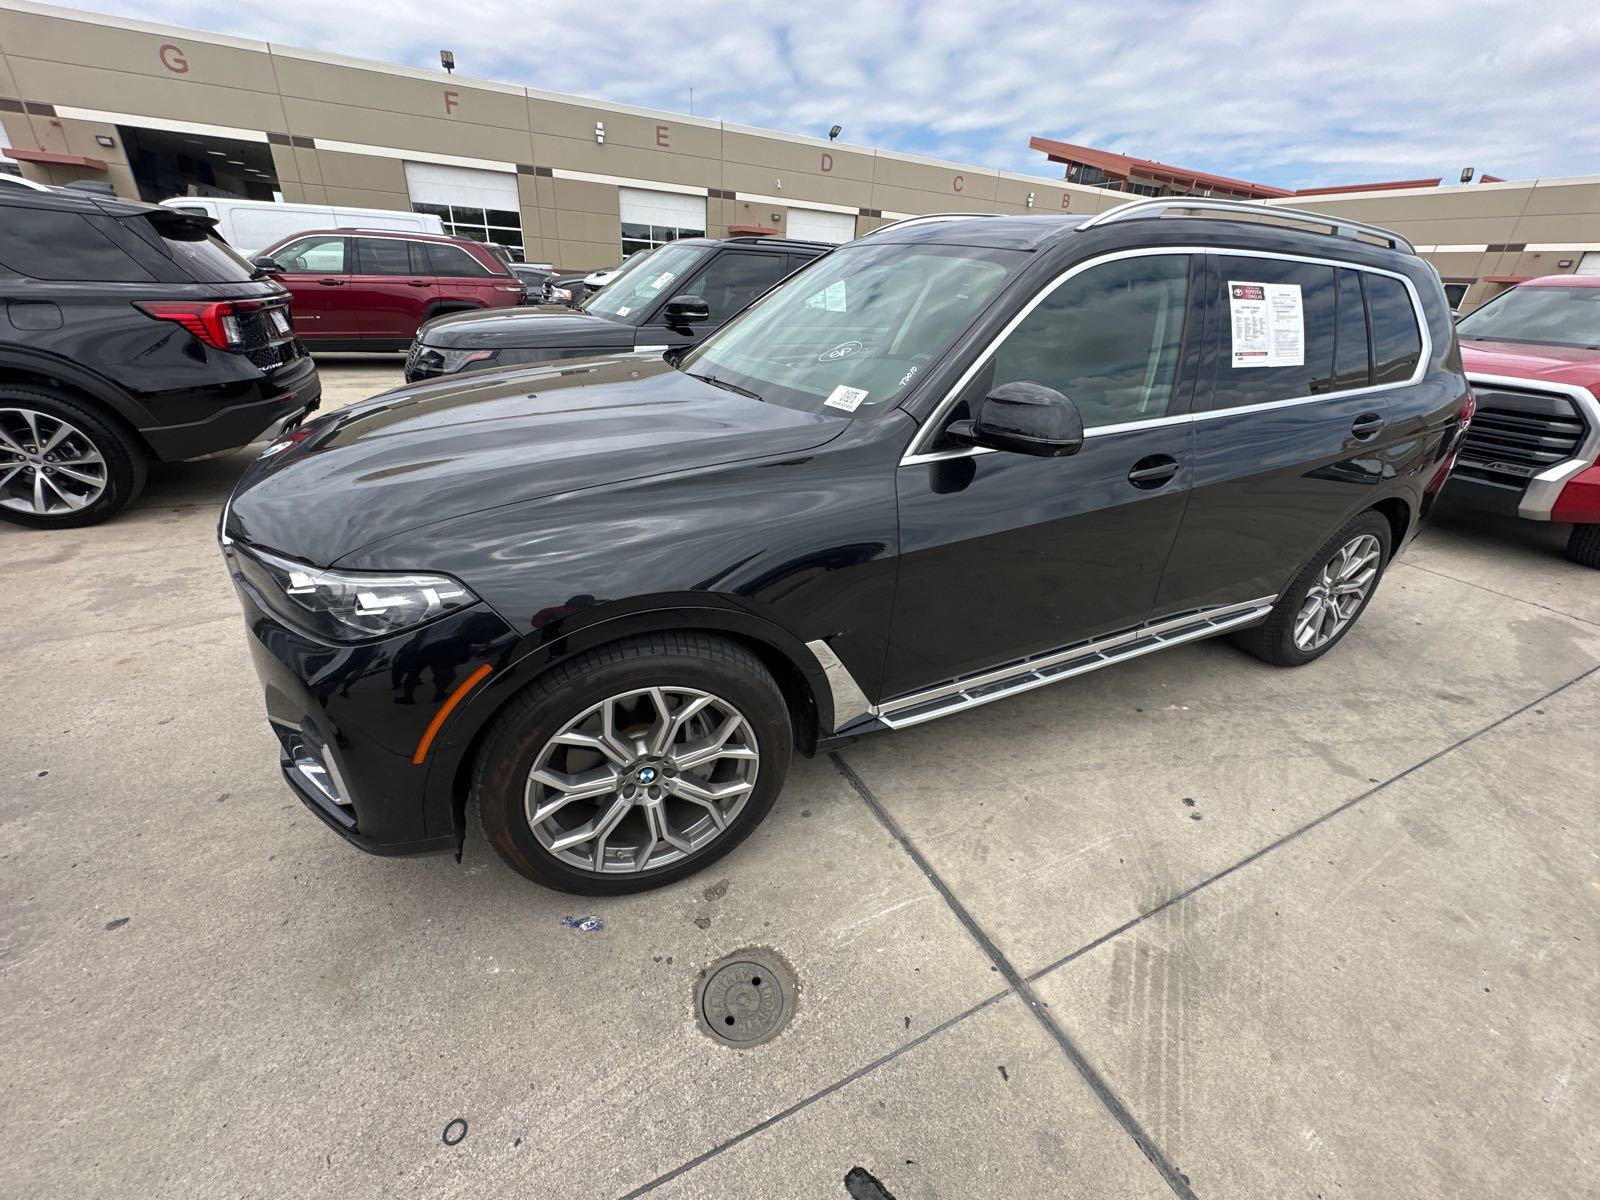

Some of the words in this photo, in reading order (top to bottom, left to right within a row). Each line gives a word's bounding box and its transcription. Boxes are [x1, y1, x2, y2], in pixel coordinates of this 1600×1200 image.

[159, 44, 188, 73] G
[444, 91, 459, 114] F
[655, 125, 670, 147] E
[820, 152, 834, 172] D
[953, 175, 964, 192] C
[1061, 193, 1071, 209] B
